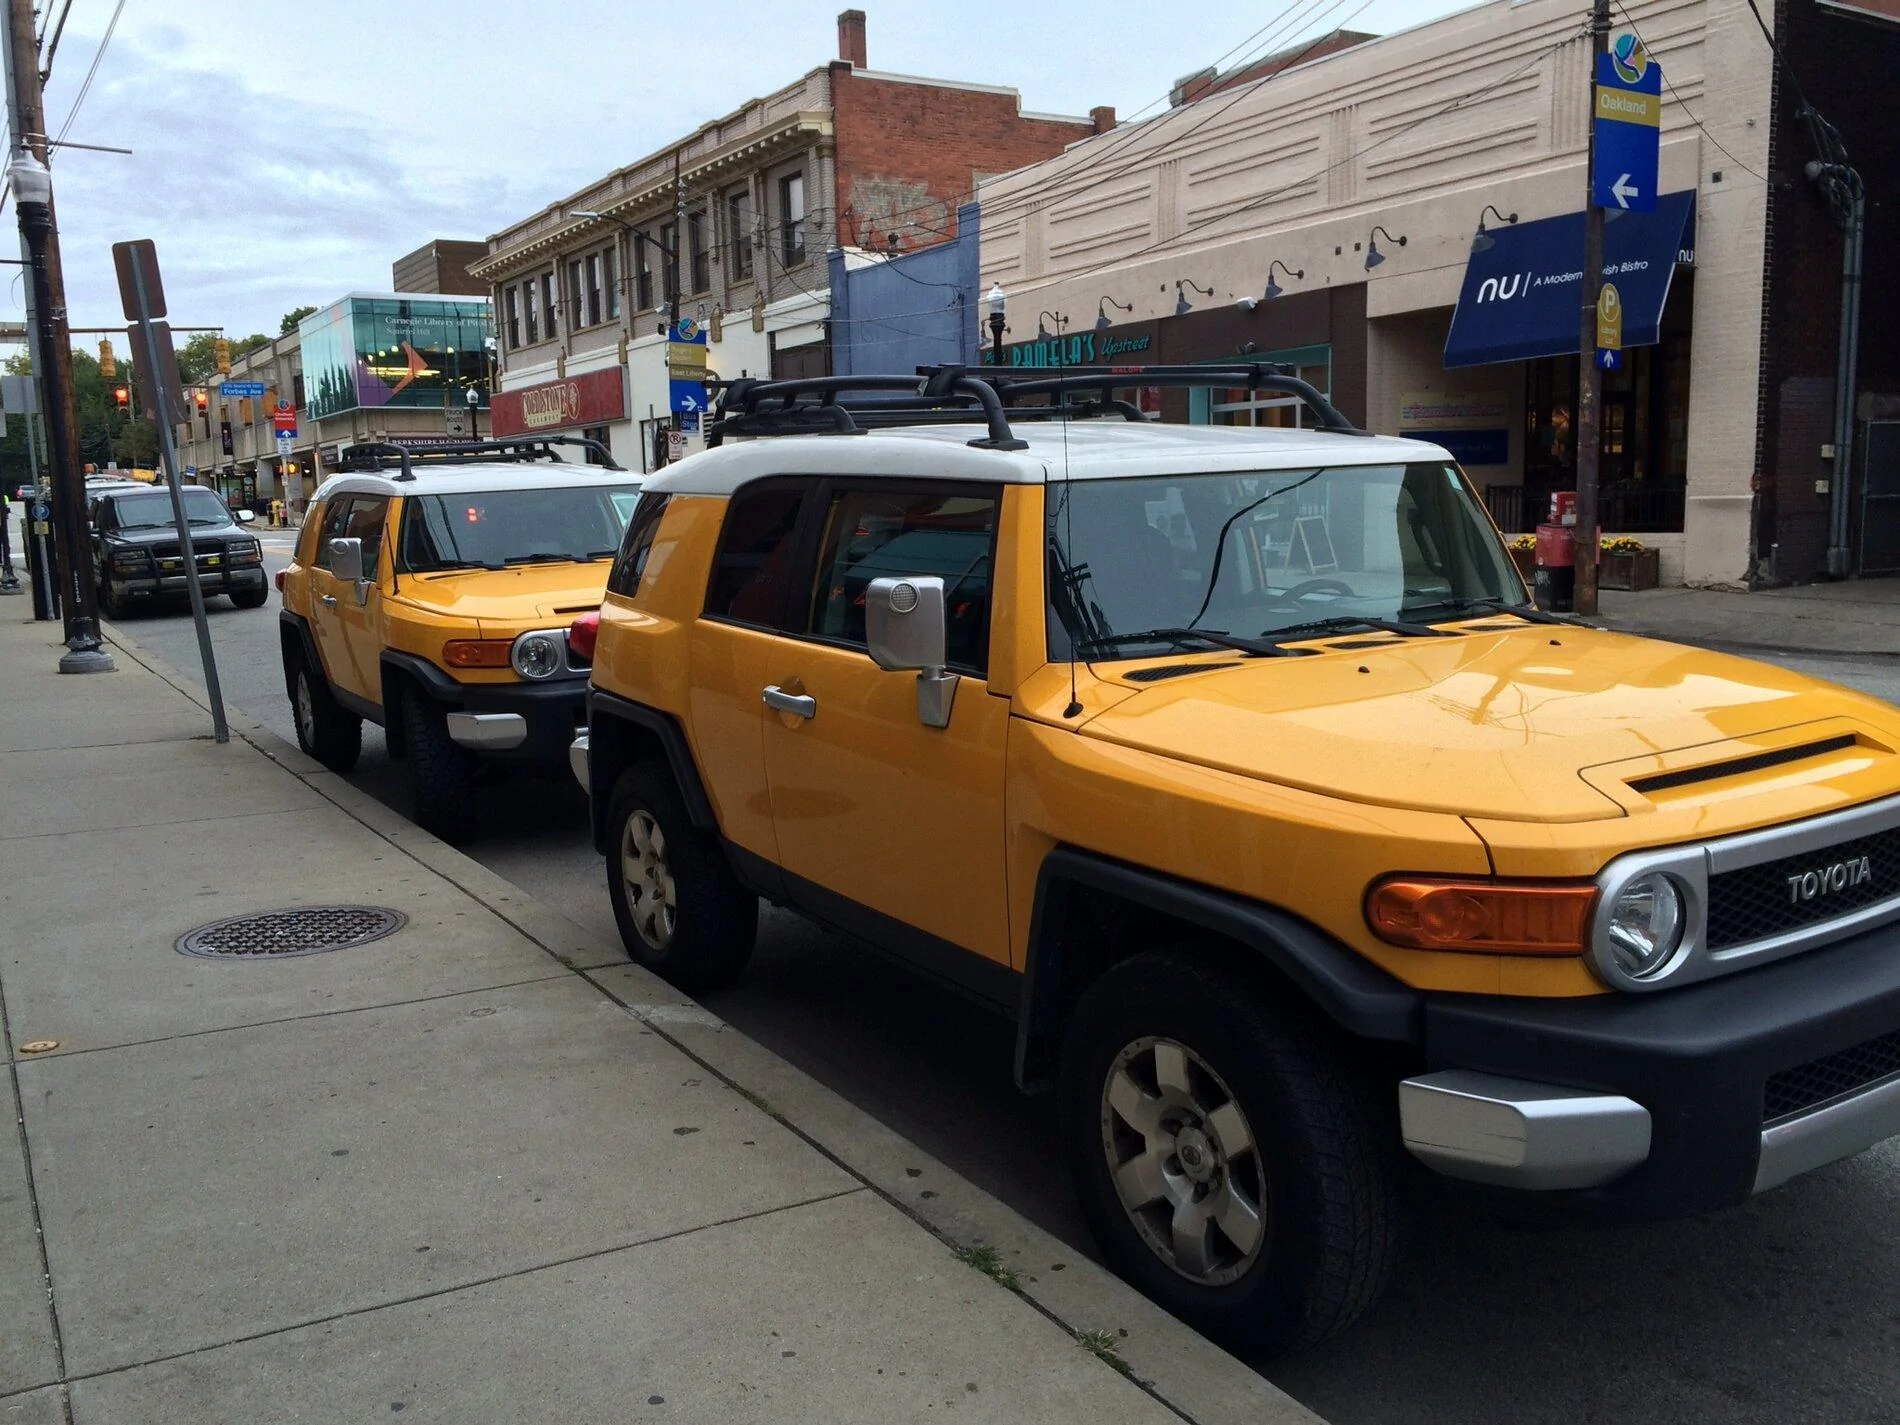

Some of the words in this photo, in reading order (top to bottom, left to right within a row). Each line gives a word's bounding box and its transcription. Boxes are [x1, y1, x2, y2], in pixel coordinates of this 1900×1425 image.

[1601, 94, 1647, 115] Oakland
[1677, 250, 1694, 262] nu
[1477, 274, 1521, 304] nu
[1533, 276, 1545, 287] A
[1545, 271, 1583, 285] Modern
[1620, 260, 1648, 273] Bistro
[385, 315, 421, 326] Carnegie
[424, 317, 453, 327] Library
[1012, 334, 1095, 367] PAMELA'S
[1101, 335, 1150, 361] Upstreet
[1787, 856, 1872, 903] TOYOTA
